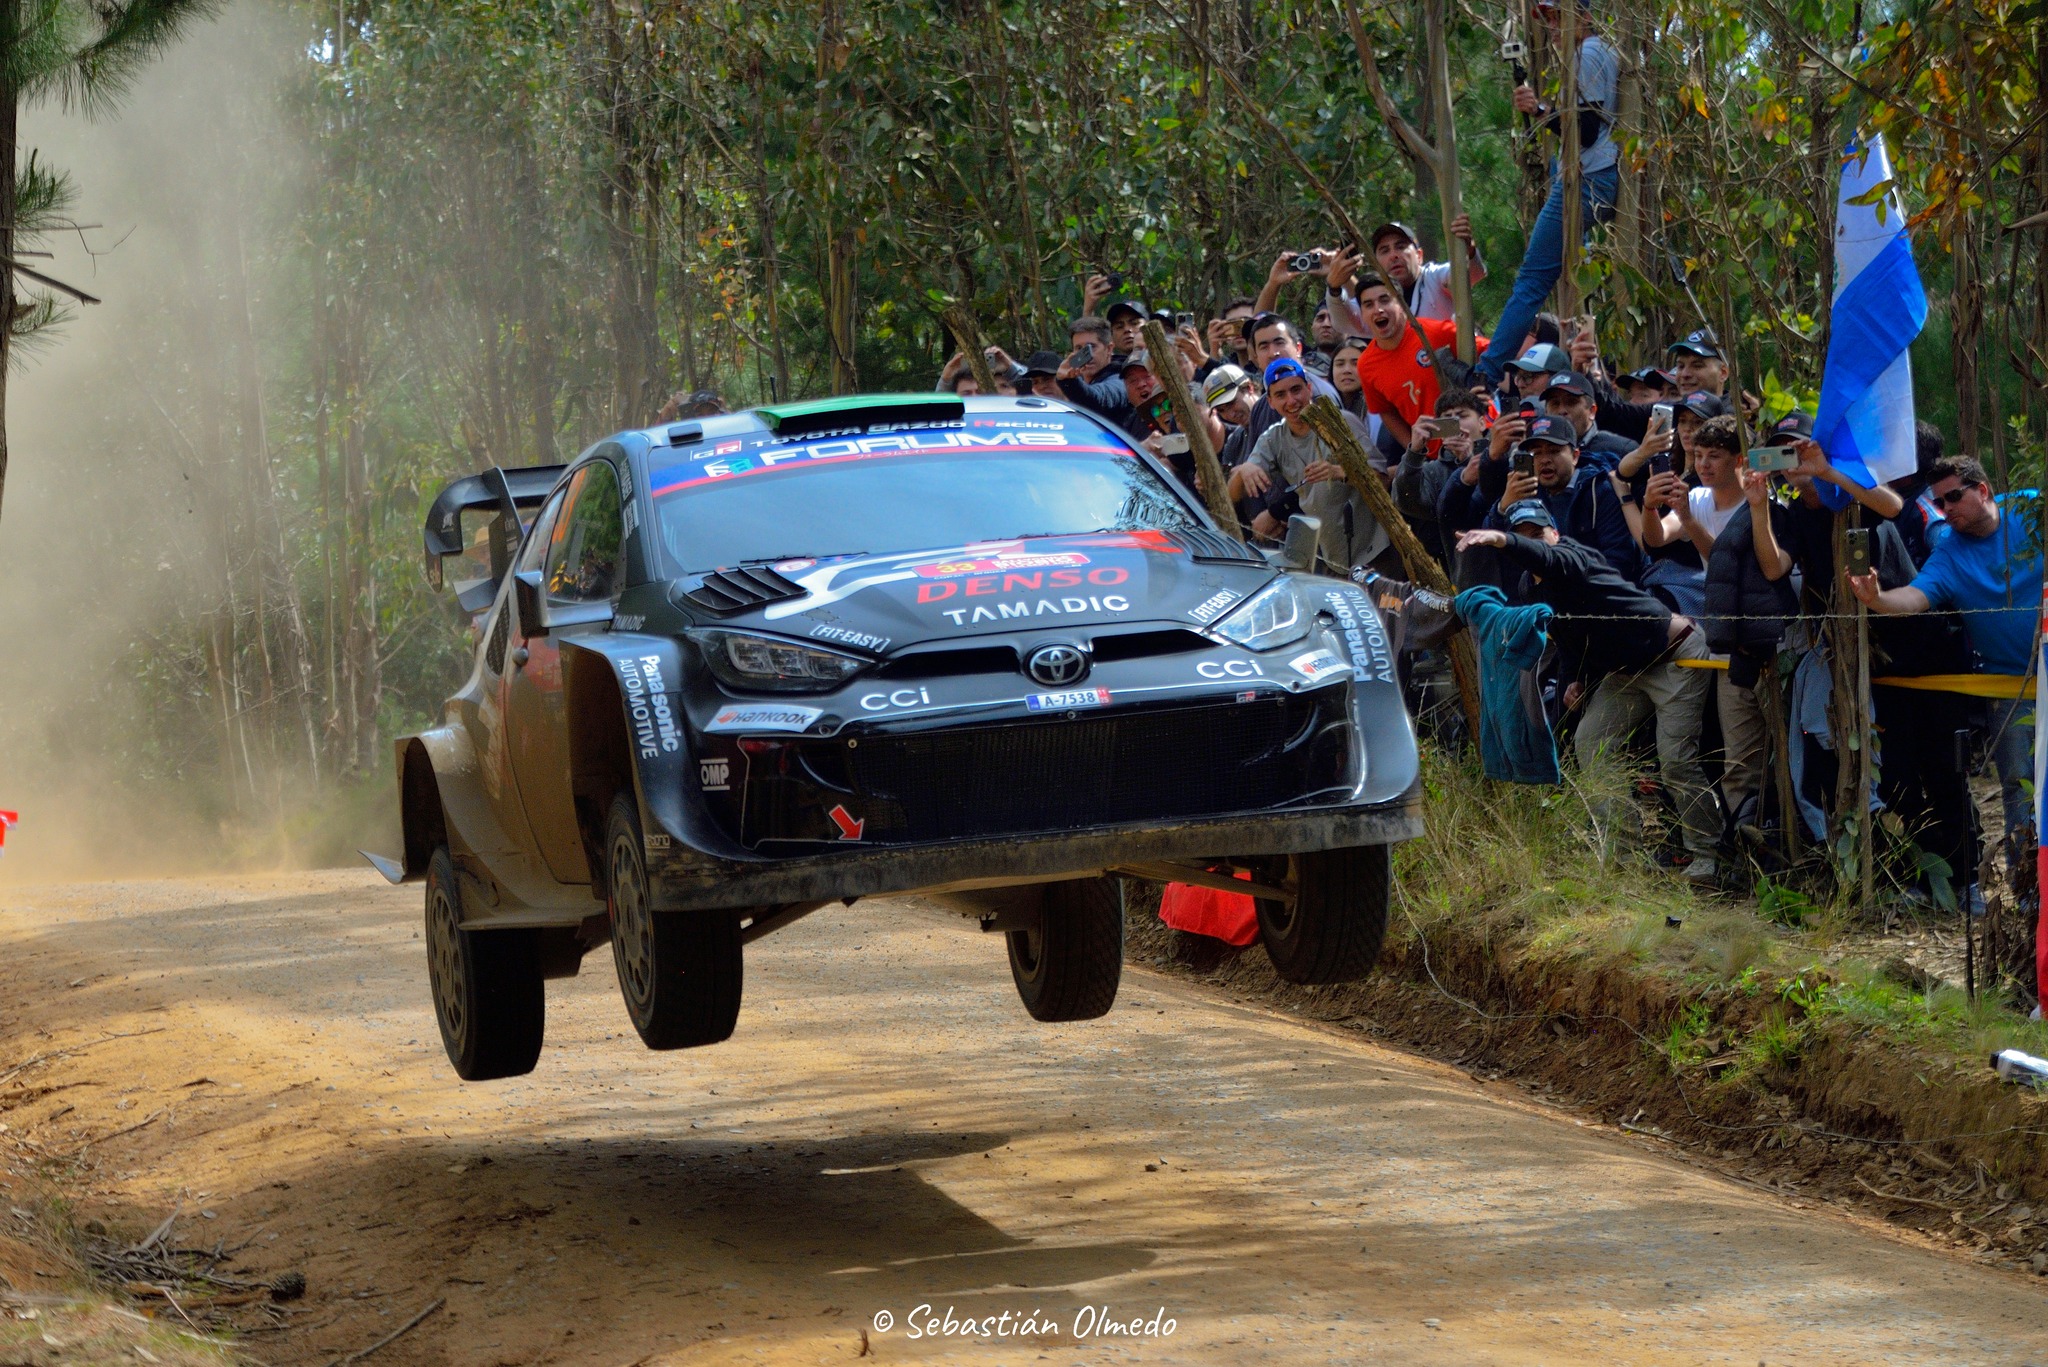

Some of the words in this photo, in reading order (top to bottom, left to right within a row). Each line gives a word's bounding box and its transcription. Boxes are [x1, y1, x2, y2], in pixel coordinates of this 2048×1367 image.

[750, 424, 861, 447] TOYOTA
[759, 432, 1068, 466] FORUM8
[690, 442, 741, 461] GR
[936, 561, 977, 574] 33
[917, 567, 1130, 604] DENSO
[943, 596, 1130, 625] TAMADIC
[1325, 592, 1372, 682] Panasonic
[1344, 590, 1393, 683] AUTOMOTIVE
[617, 658, 659, 760] AUTOMOTIVE
[639, 655, 682, 752] Panasonic
[1045, 692, 1096, 707] A-7538
[700, 764, 730, 786] OMP
